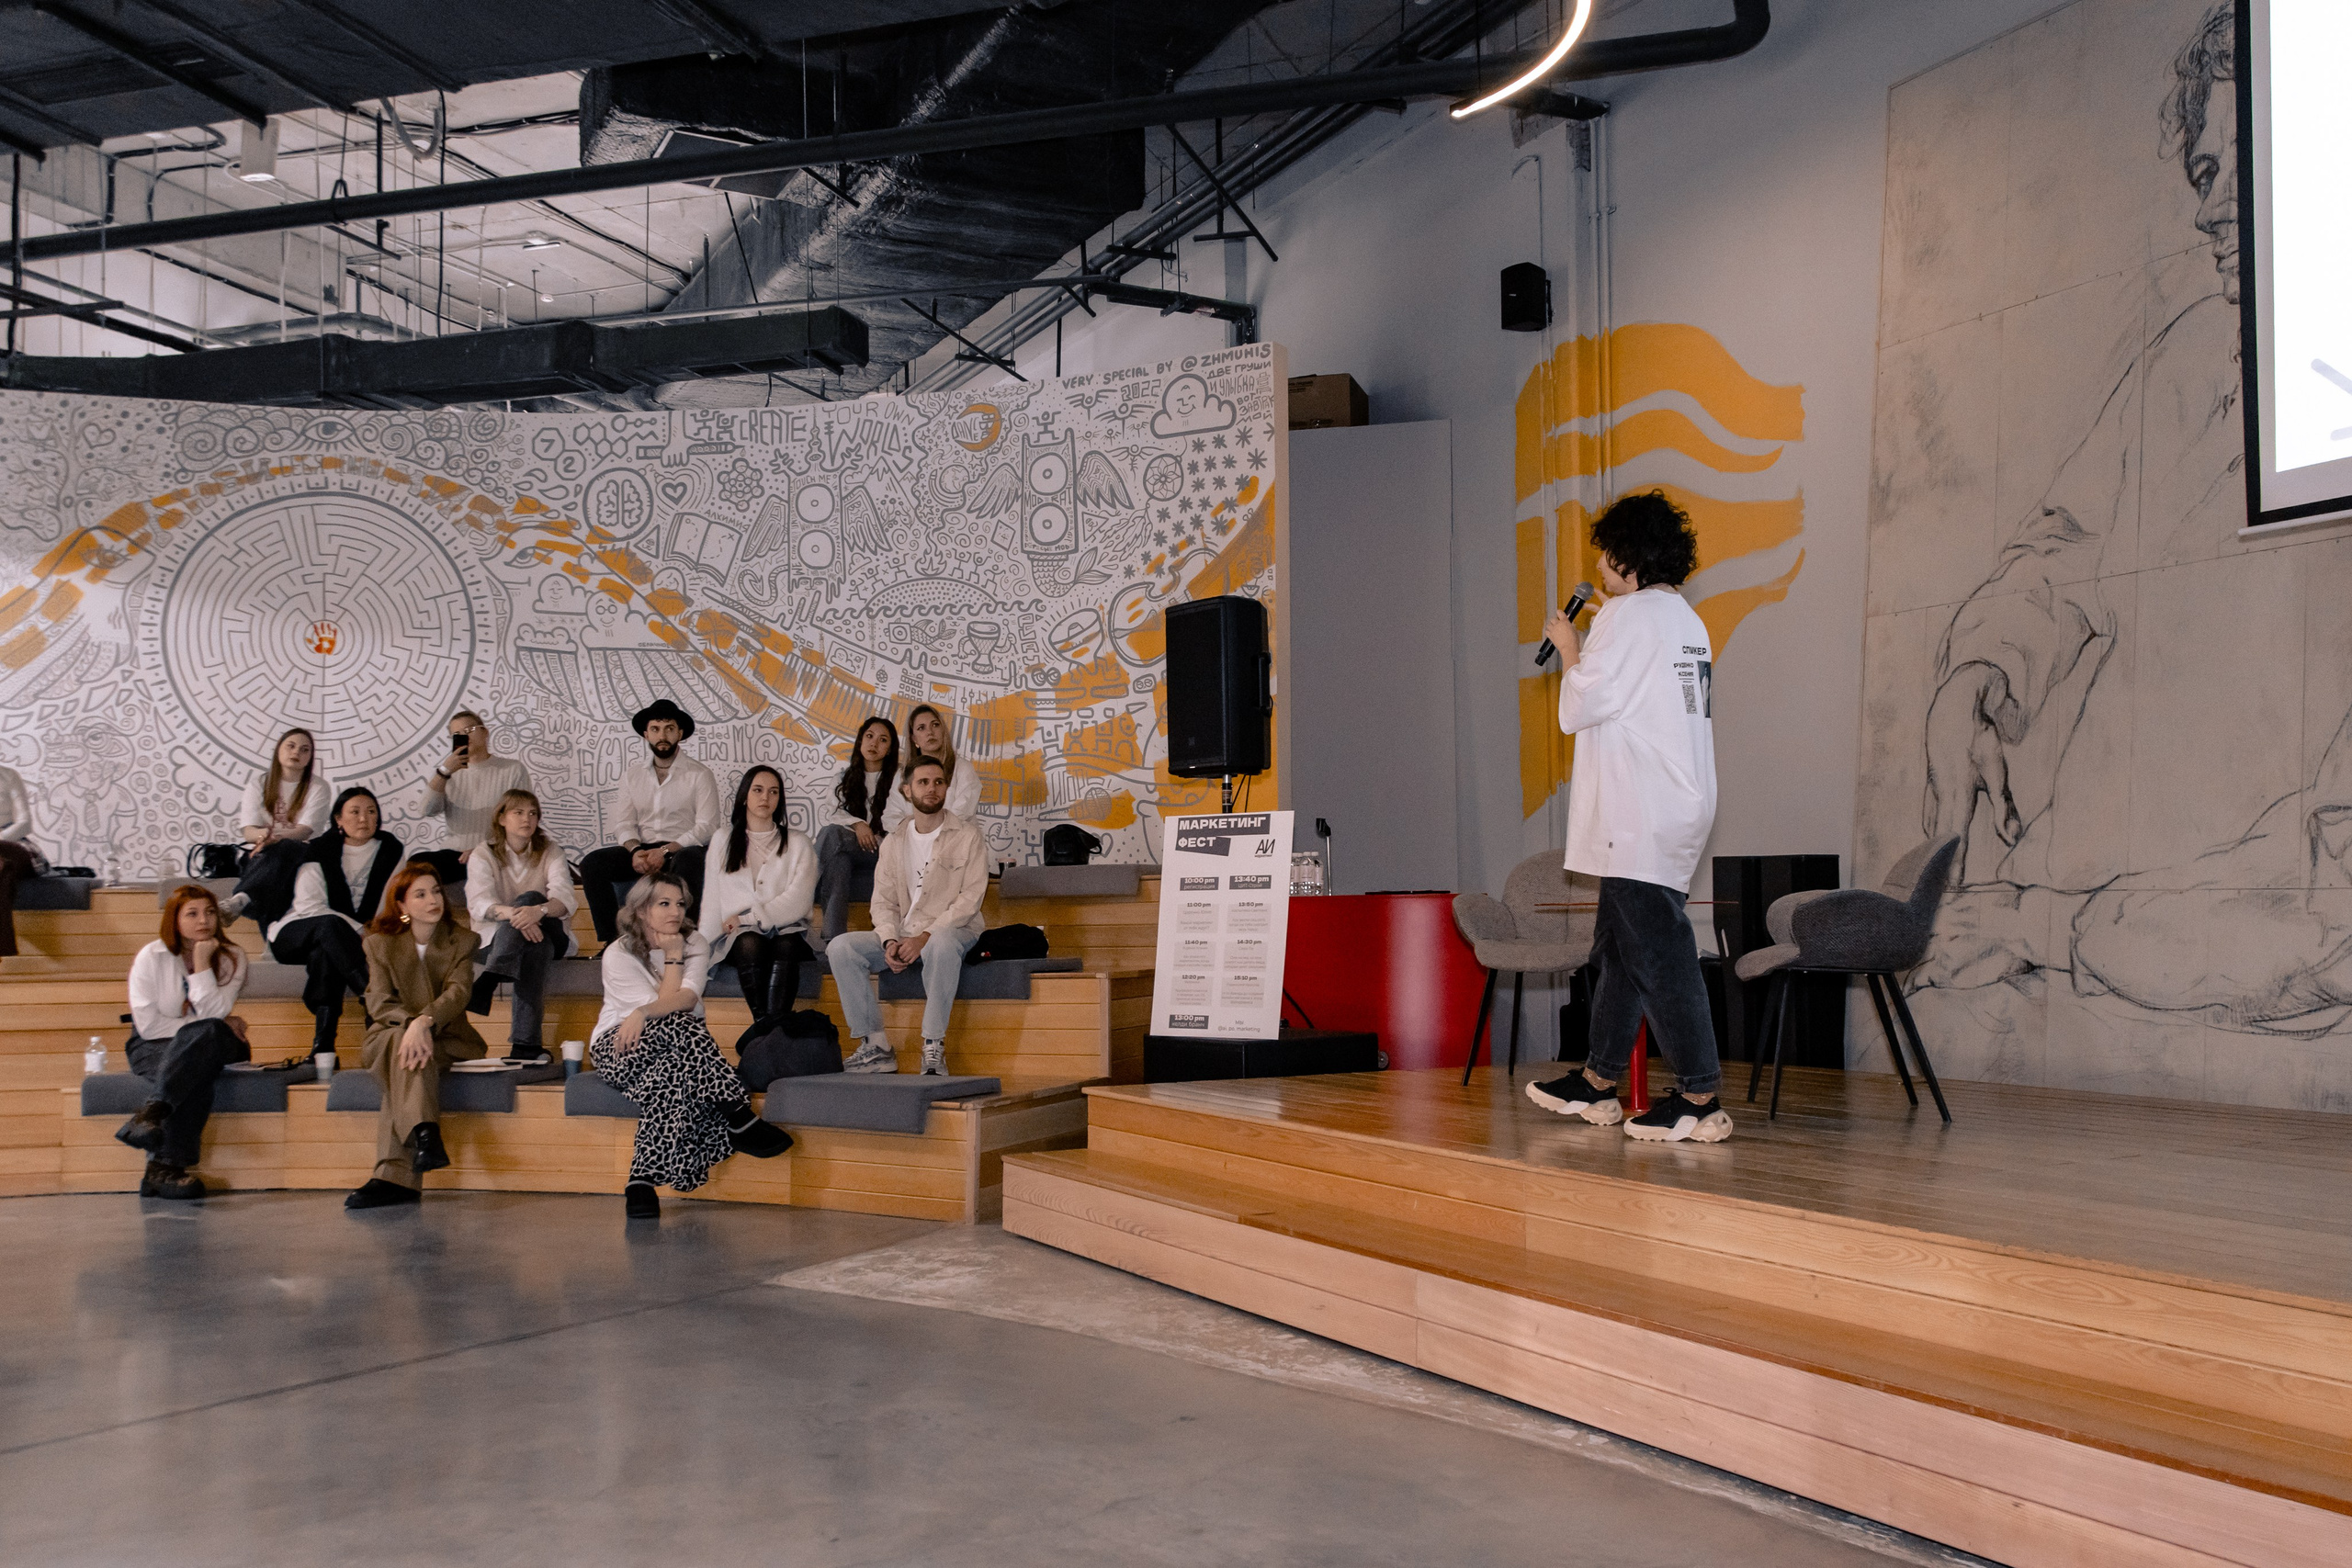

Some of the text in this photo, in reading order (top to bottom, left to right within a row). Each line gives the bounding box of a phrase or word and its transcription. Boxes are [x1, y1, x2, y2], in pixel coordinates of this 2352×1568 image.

[1062, 374, 1093, 389] VERY
[1102, 367, 1149, 385] SPECIAL
[1156, 360, 1173, 374] BY
[1207, 361, 1272, 379] ДВЕ ГРУШИ
[1121, 379, 1161, 401] 2022
[1209, 374, 1255, 397] И УЛЫБКА
[1237, 393, 1257, 405] ВОТ
[740, 401, 915, 446] CREATE YOUR OWN
[540, 438, 556, 453] 7
[563, 457, 577, 473] 2
[792, 474, 831, 491] TOUCH ME
[704, 508, 751, 534] АЛХИМИЯ
[830, 516, 842, 575] MORNING
[1682, 646, 1706, 656] СПИКЕР
[491, 656, 534, 707] ALL
[543, 699, 571, 716] EVER
[608, 724, 628, 734] ALL
[694, 725, 730, 739] eeded
[576, 748, 595, 787] IS
[732, 723, 755, 763] MY
[754, 733, 837, 771] ARMS
[1179, 817, 1266, 830] МАРКЕТИНГ
[1178, 837, 1216, 848] ФЕСТ
[1255, 839, 1275, 854] АИ
